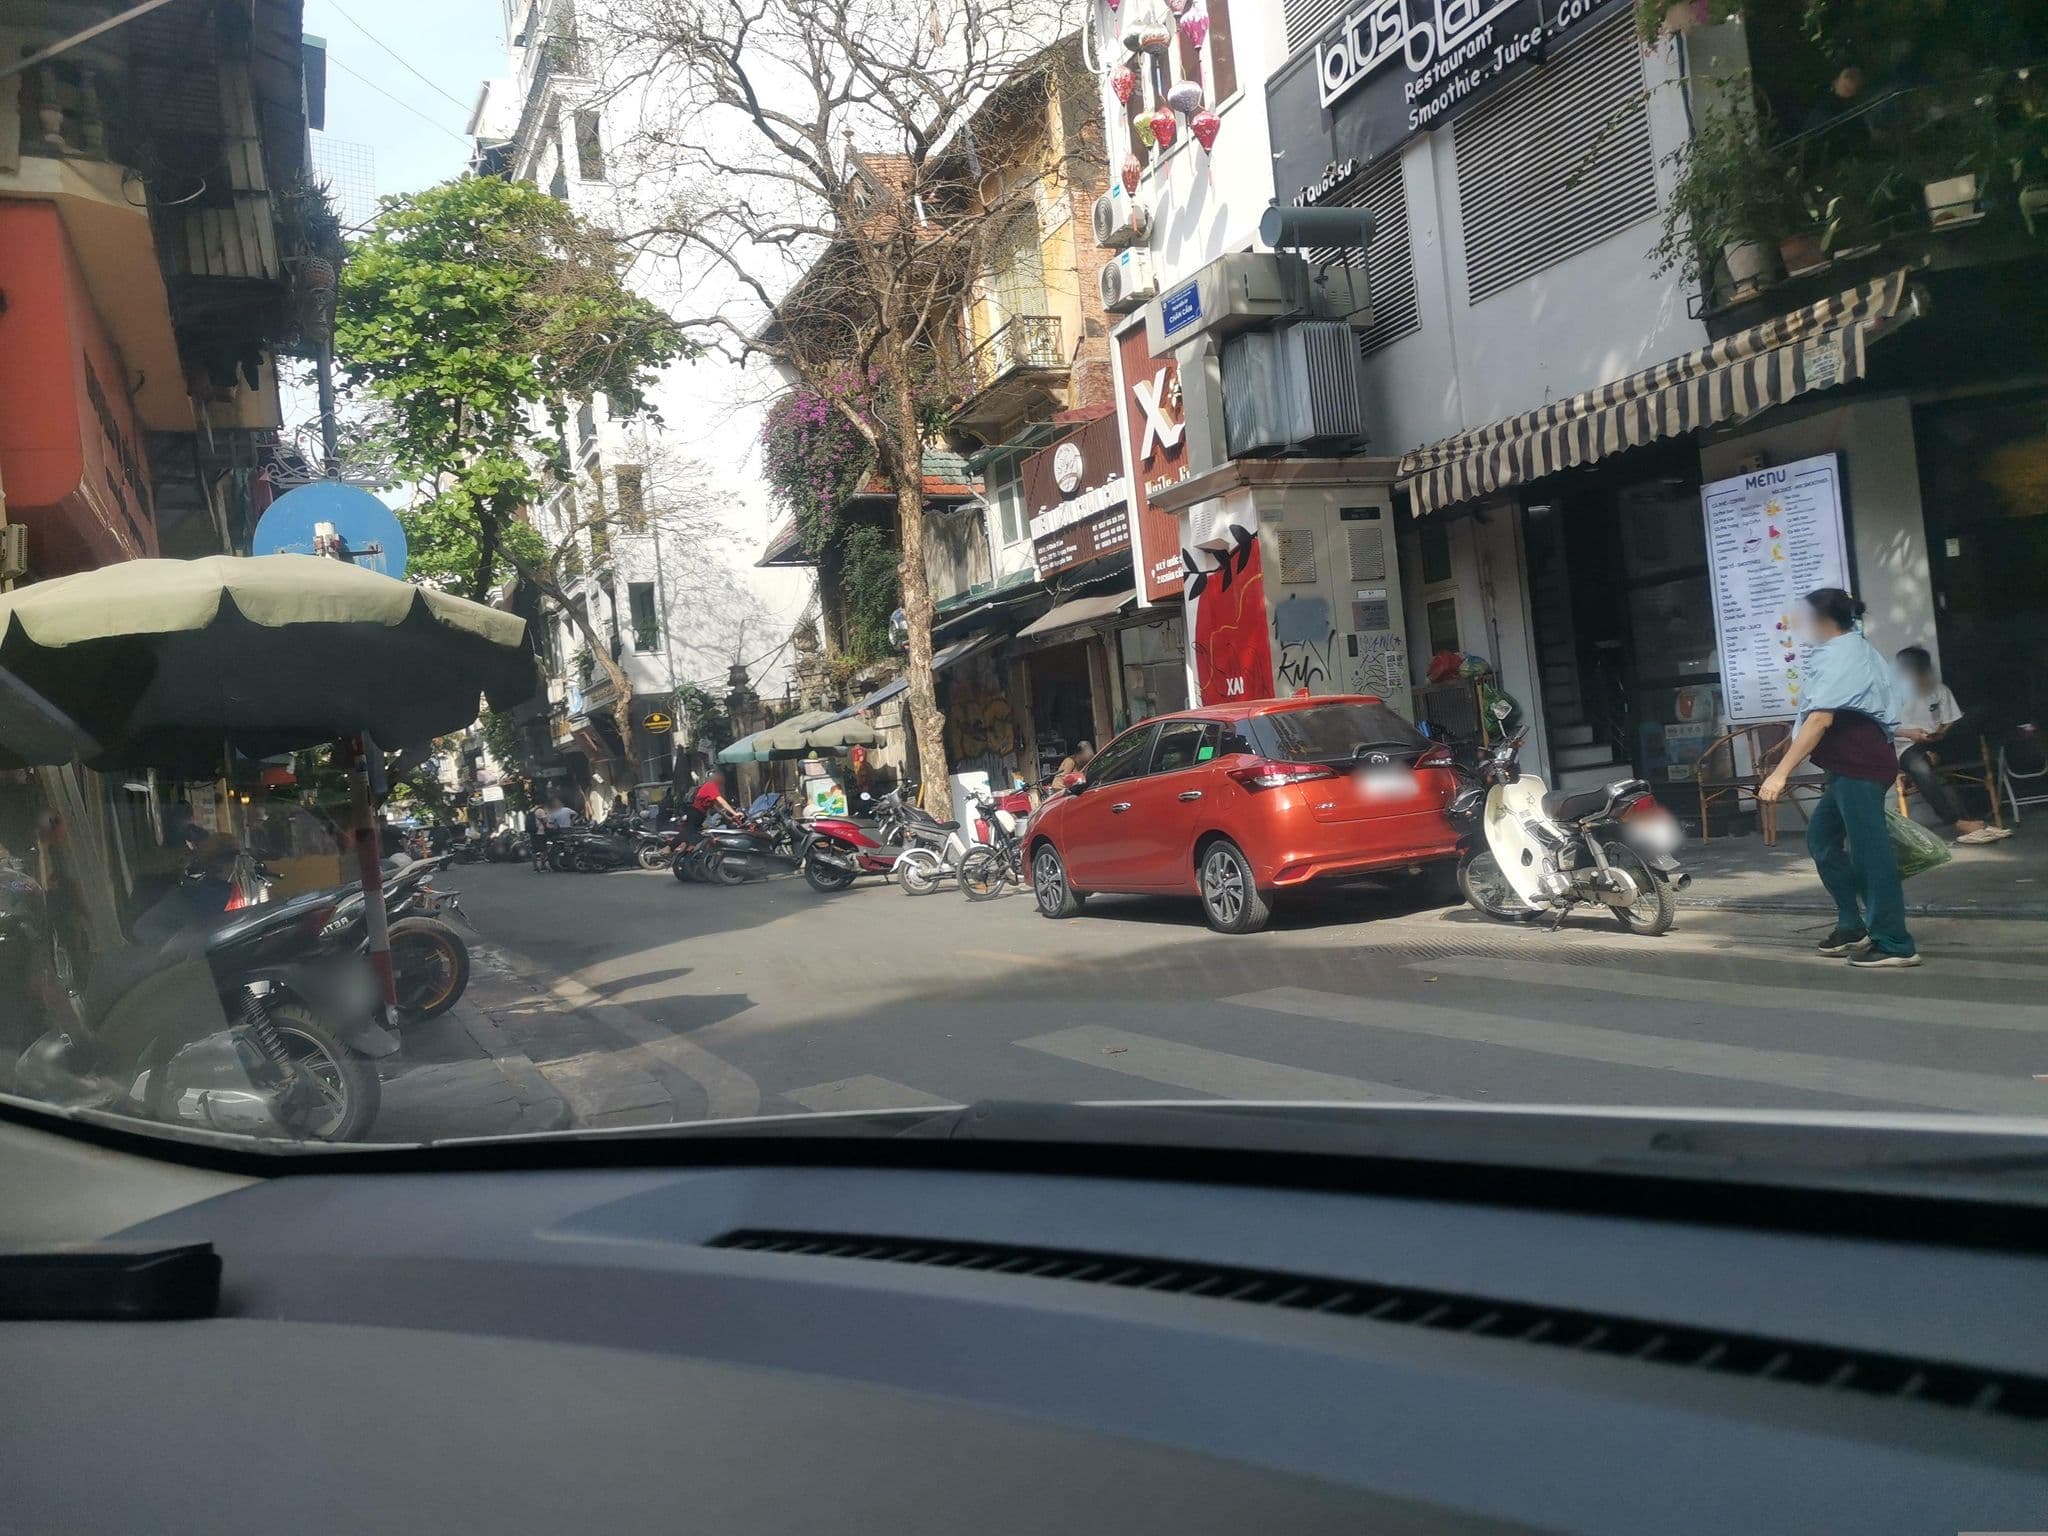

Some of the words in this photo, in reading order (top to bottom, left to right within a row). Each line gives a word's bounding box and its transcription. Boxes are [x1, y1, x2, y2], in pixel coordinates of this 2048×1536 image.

[1404, 24, 1494, 104] Restaurant
[1407, 68, 1481, 131] Smoothie
[1493, 26, 1542, 72] Juice
[1745, 469, 1787, 490] MENU
[1226, 676, 1245, 696] XAI
